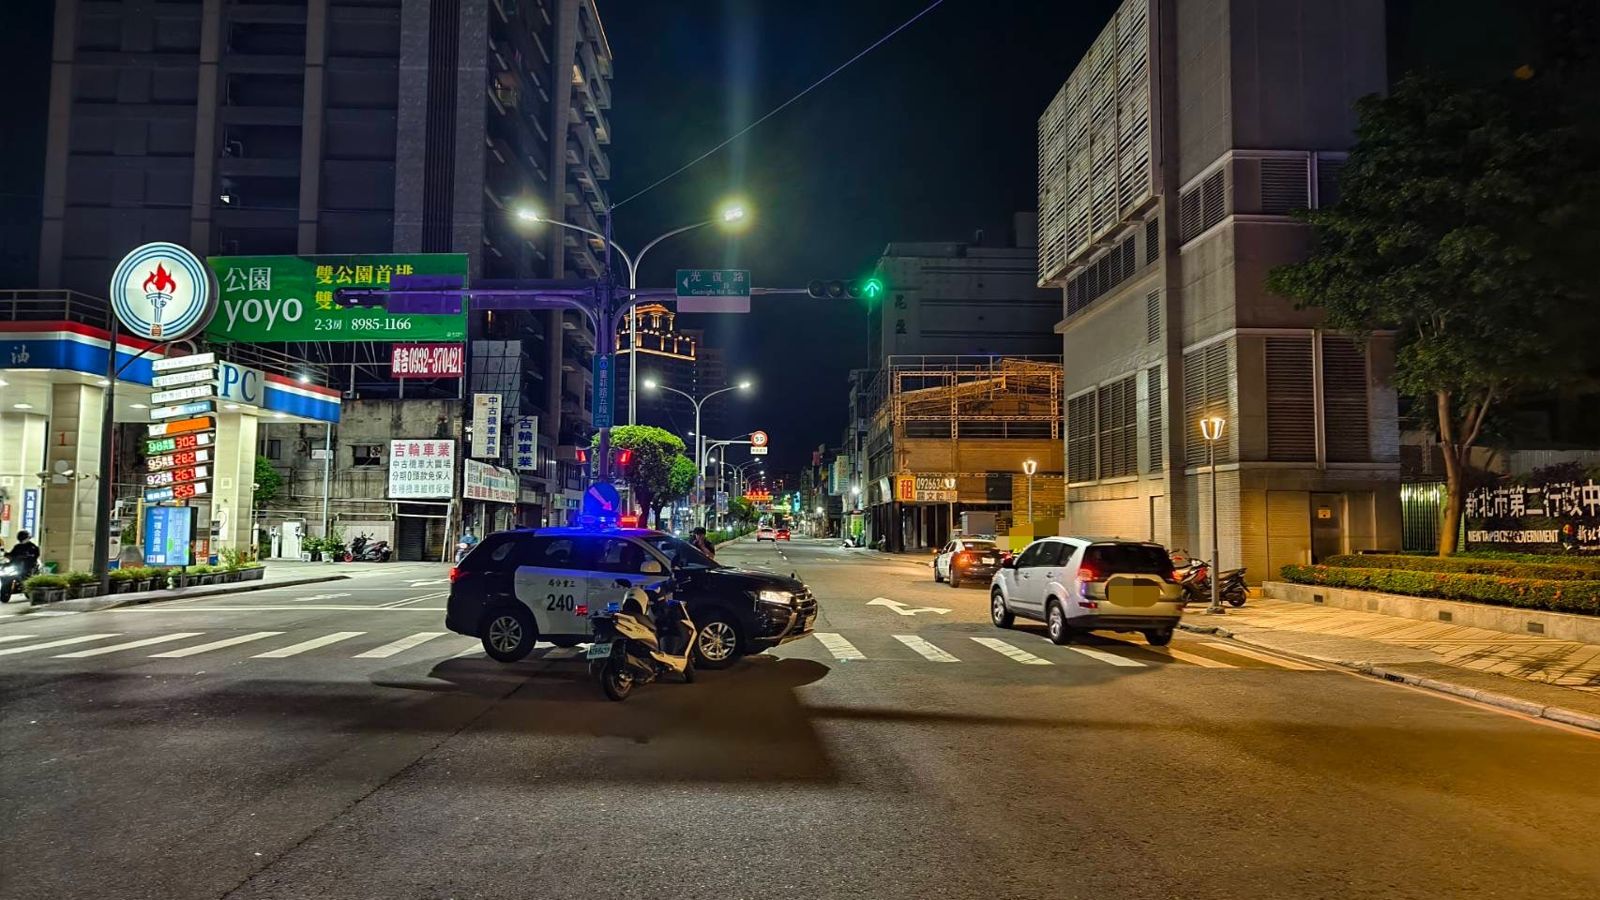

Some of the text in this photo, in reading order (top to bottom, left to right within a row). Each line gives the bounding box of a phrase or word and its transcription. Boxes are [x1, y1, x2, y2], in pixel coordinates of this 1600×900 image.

[224, 267, 271, 292] 公園
[224, 298, 303, 332] yoyo
[314, 318, 411, 331] 2-3房 8985-1166
[11, 344, 30, 364] 油
[148, 442, 162, 452] 98
[394, 443, 450, 457] 吉輪車業
[518, 419, 534, 467] 吉輪車業
[900, 480, 913, 499] 租
[1513, 530, 1560, 543] GOVERNMENT
[547, 594, 574, 612] 240
